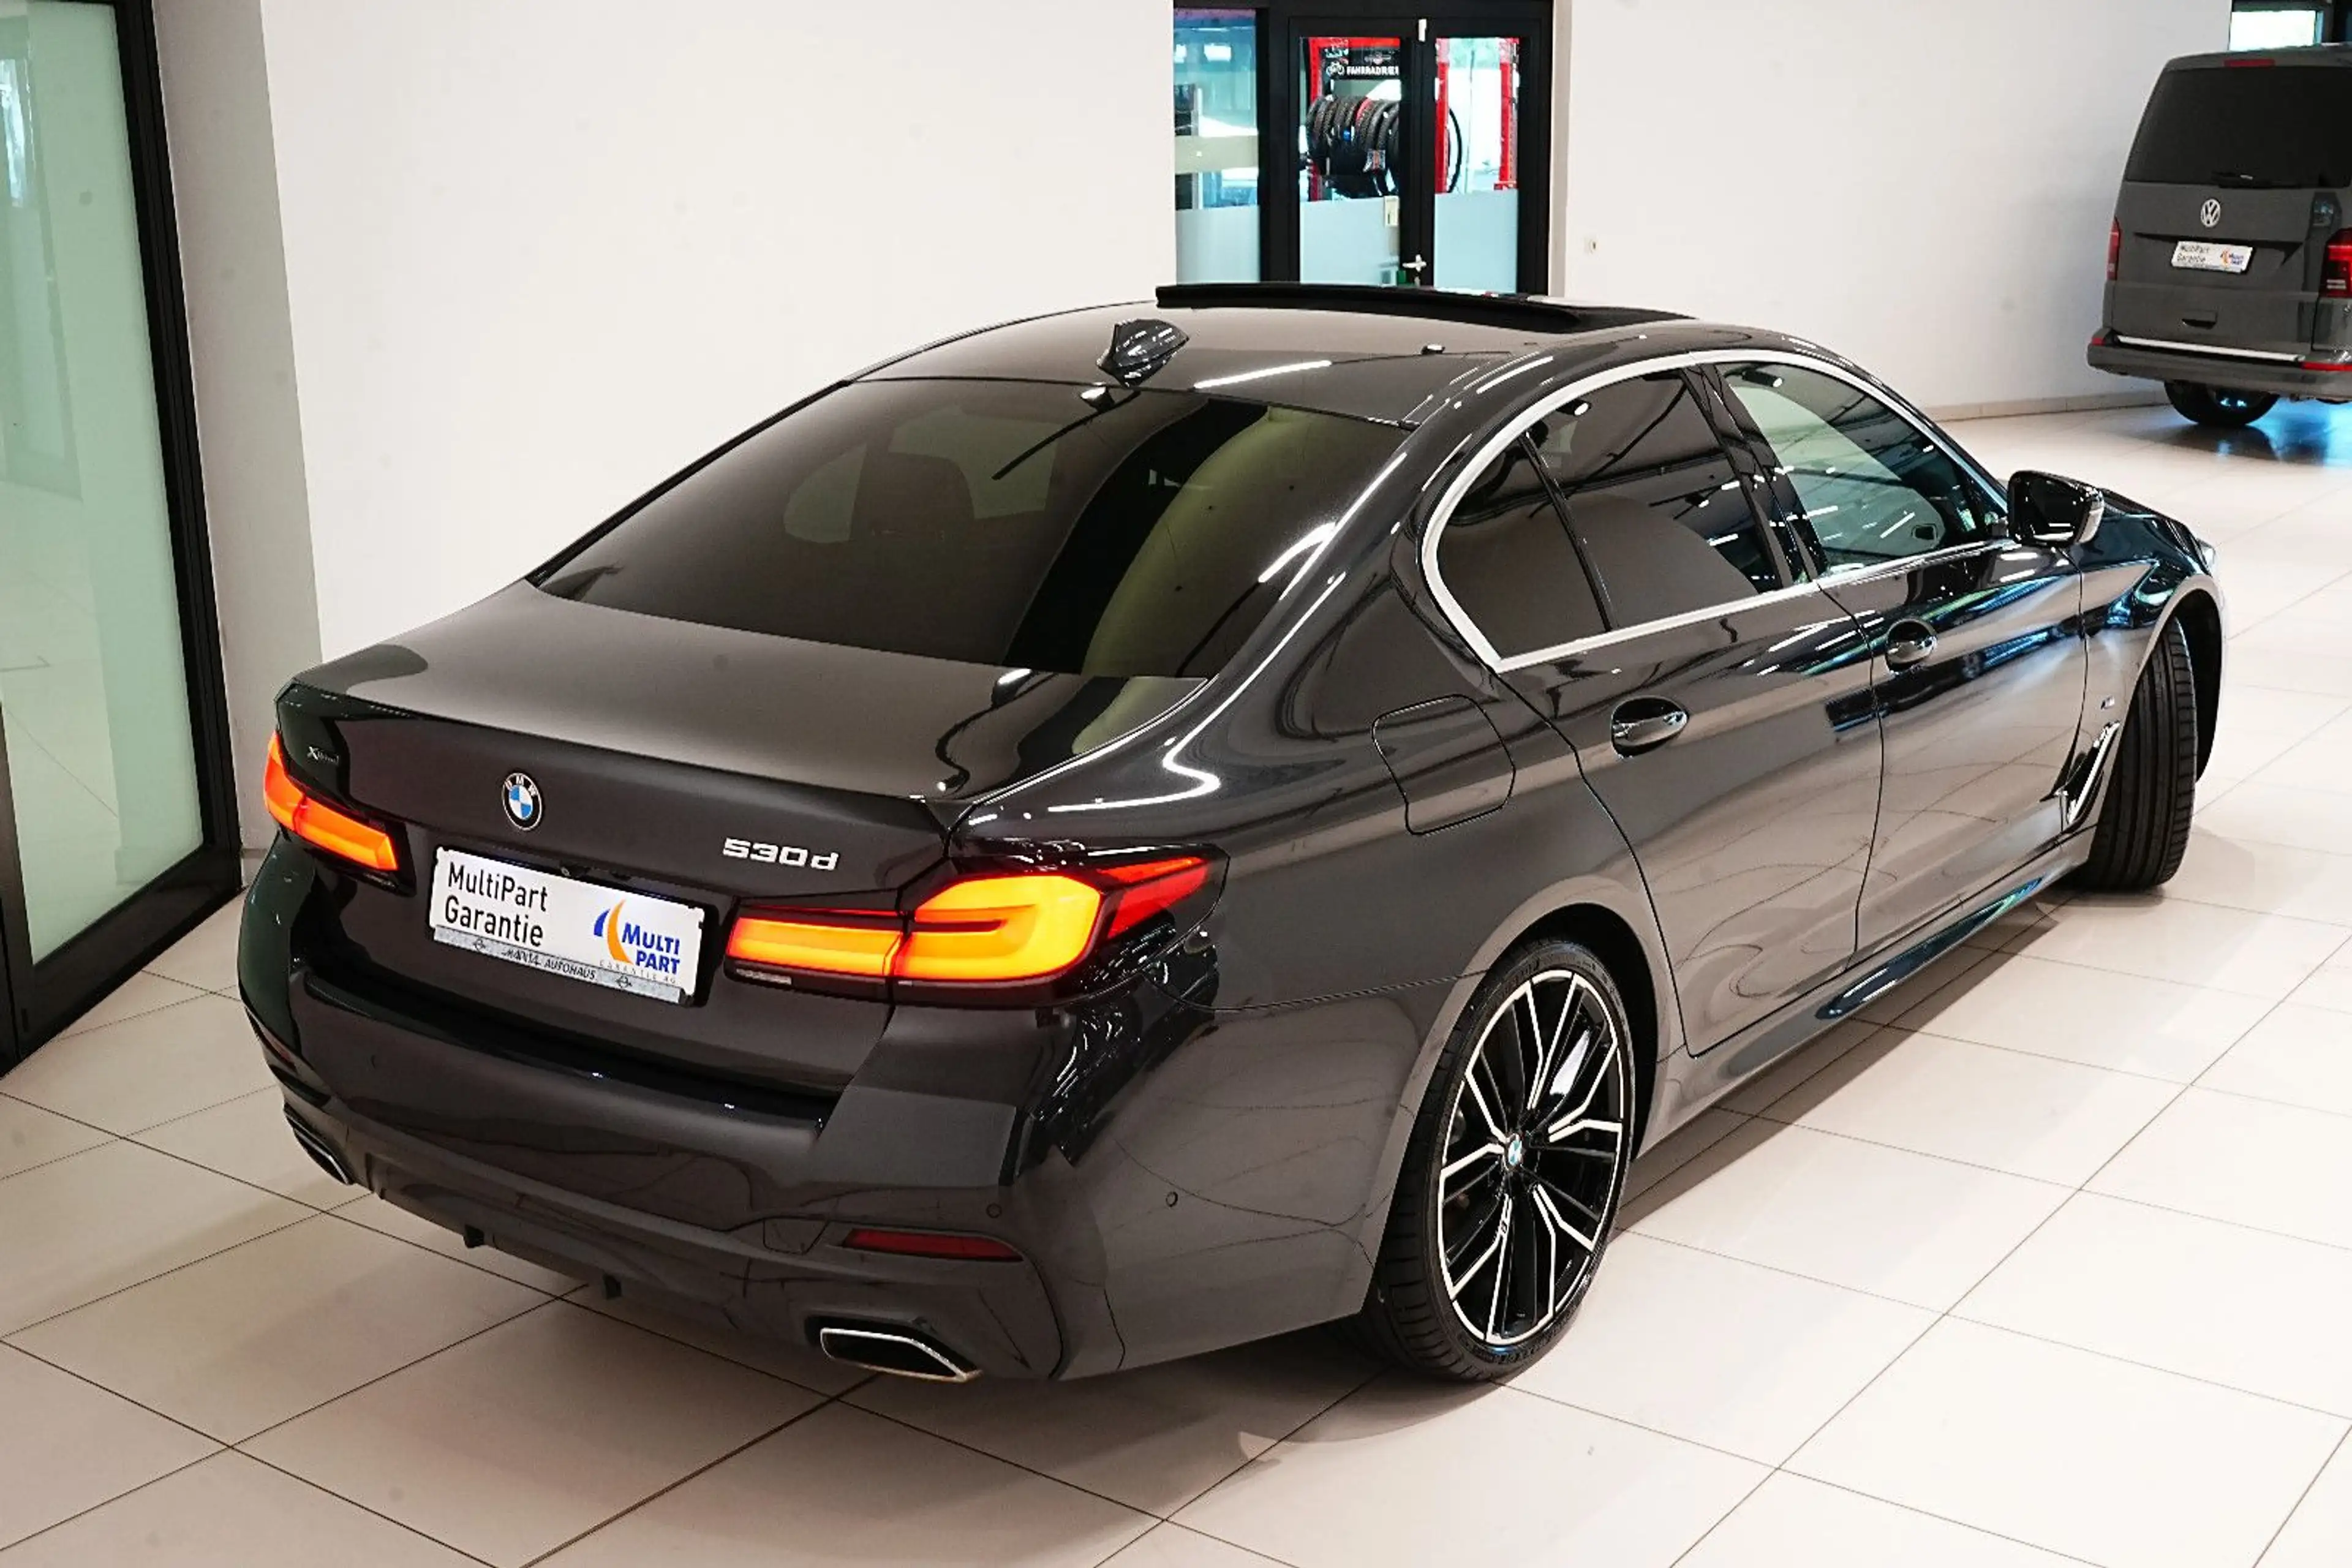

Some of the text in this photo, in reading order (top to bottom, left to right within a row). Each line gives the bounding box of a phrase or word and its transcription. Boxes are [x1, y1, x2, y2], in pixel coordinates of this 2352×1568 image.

[448, 861, 548, 912] MultiPart
[445, 895, 544, 947] Garantie
[622, 922, 680, 955] MULTI
[544, 958, 597, 979] AUTOHAUS
[636, 949, 680, 975] PART
